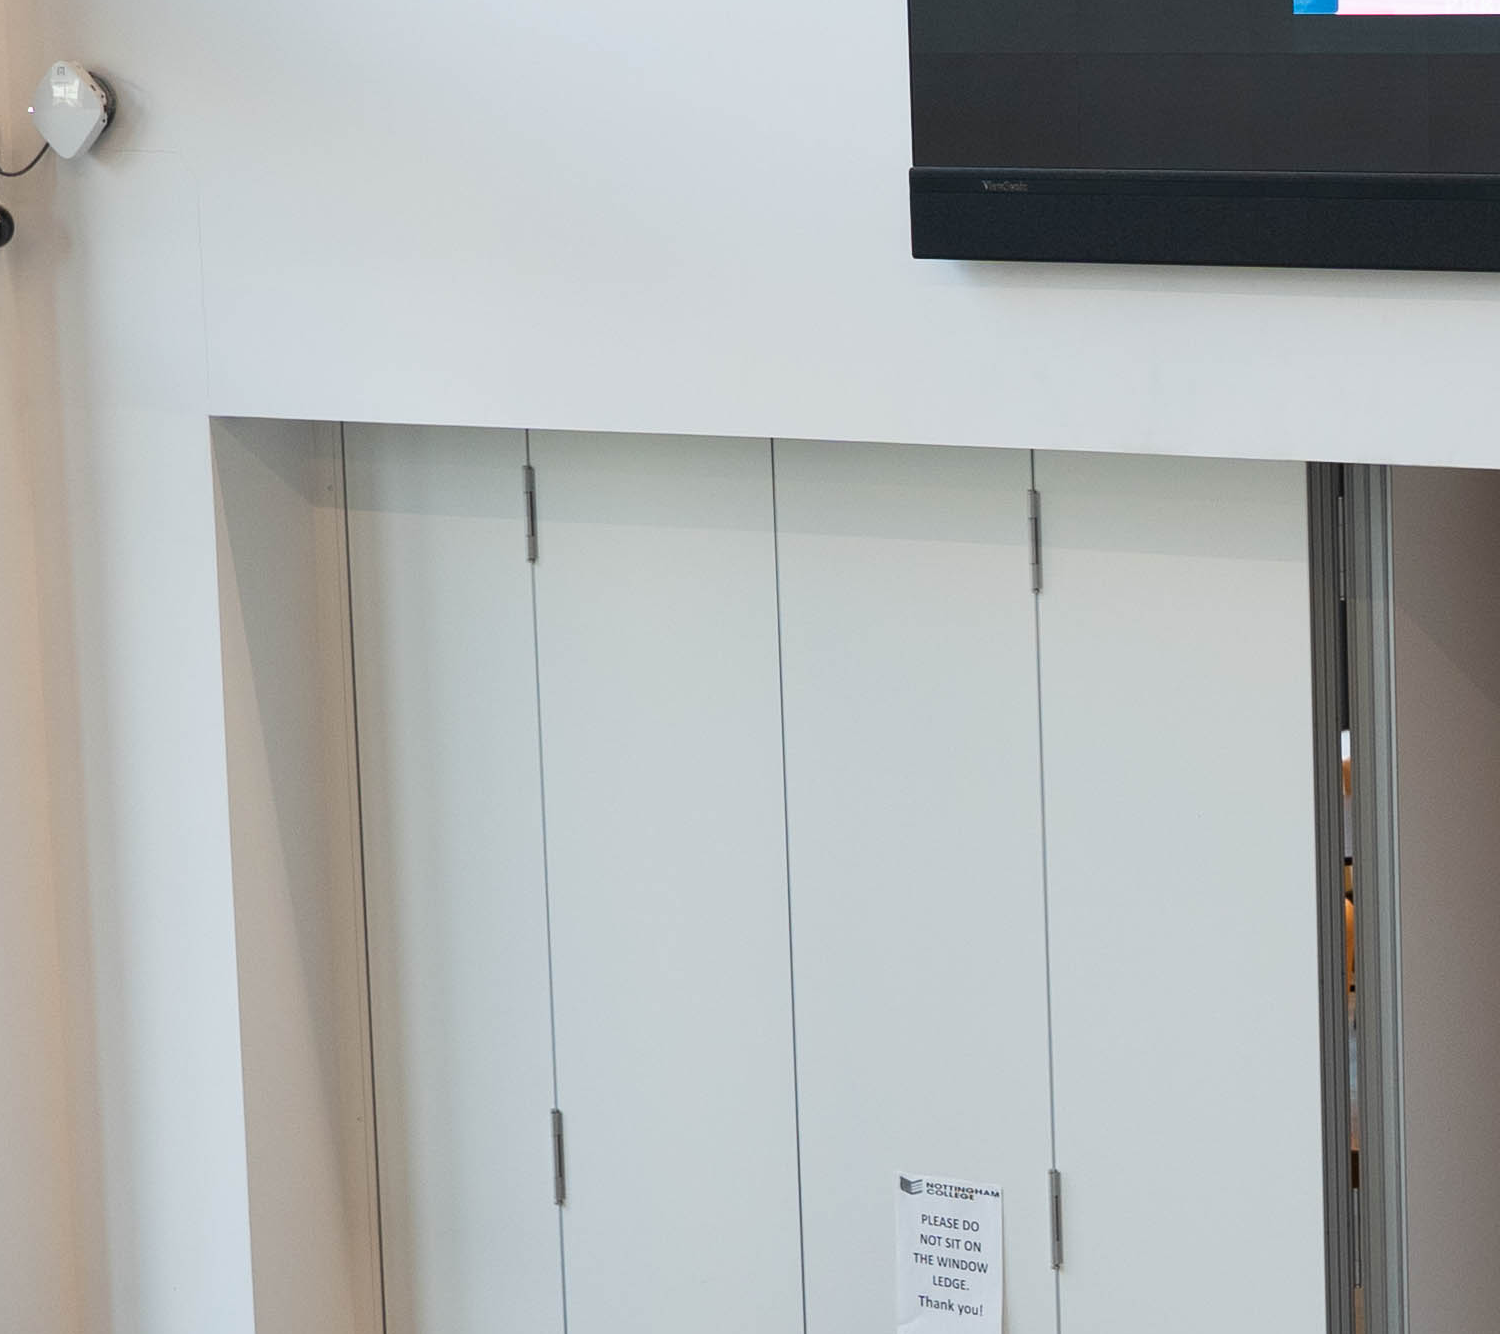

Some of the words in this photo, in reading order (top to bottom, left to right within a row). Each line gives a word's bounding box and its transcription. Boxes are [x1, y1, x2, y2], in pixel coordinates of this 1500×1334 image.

[926, 1182, 1000, 1198] NOTTINGHAM
[926, 1189, 975, 1201] COLLEGE
[921, 1214, 959, 1230] PLEASE
[962, 1219, 980, 1232] DO
[920, 1233, 942, 1247] NOT
[945, 1237, 961, 1250] SIT
[964, 1240, 982, 1253] ON
[913, 1252, 934, 1266] THE
[936, 1256, 989, 1274] WINDOW
[932, 1275, 970, 1291] LEDGE.
[918, 1295, 955, 1312] Thank
[958, 1304, 983, 1317] you!
